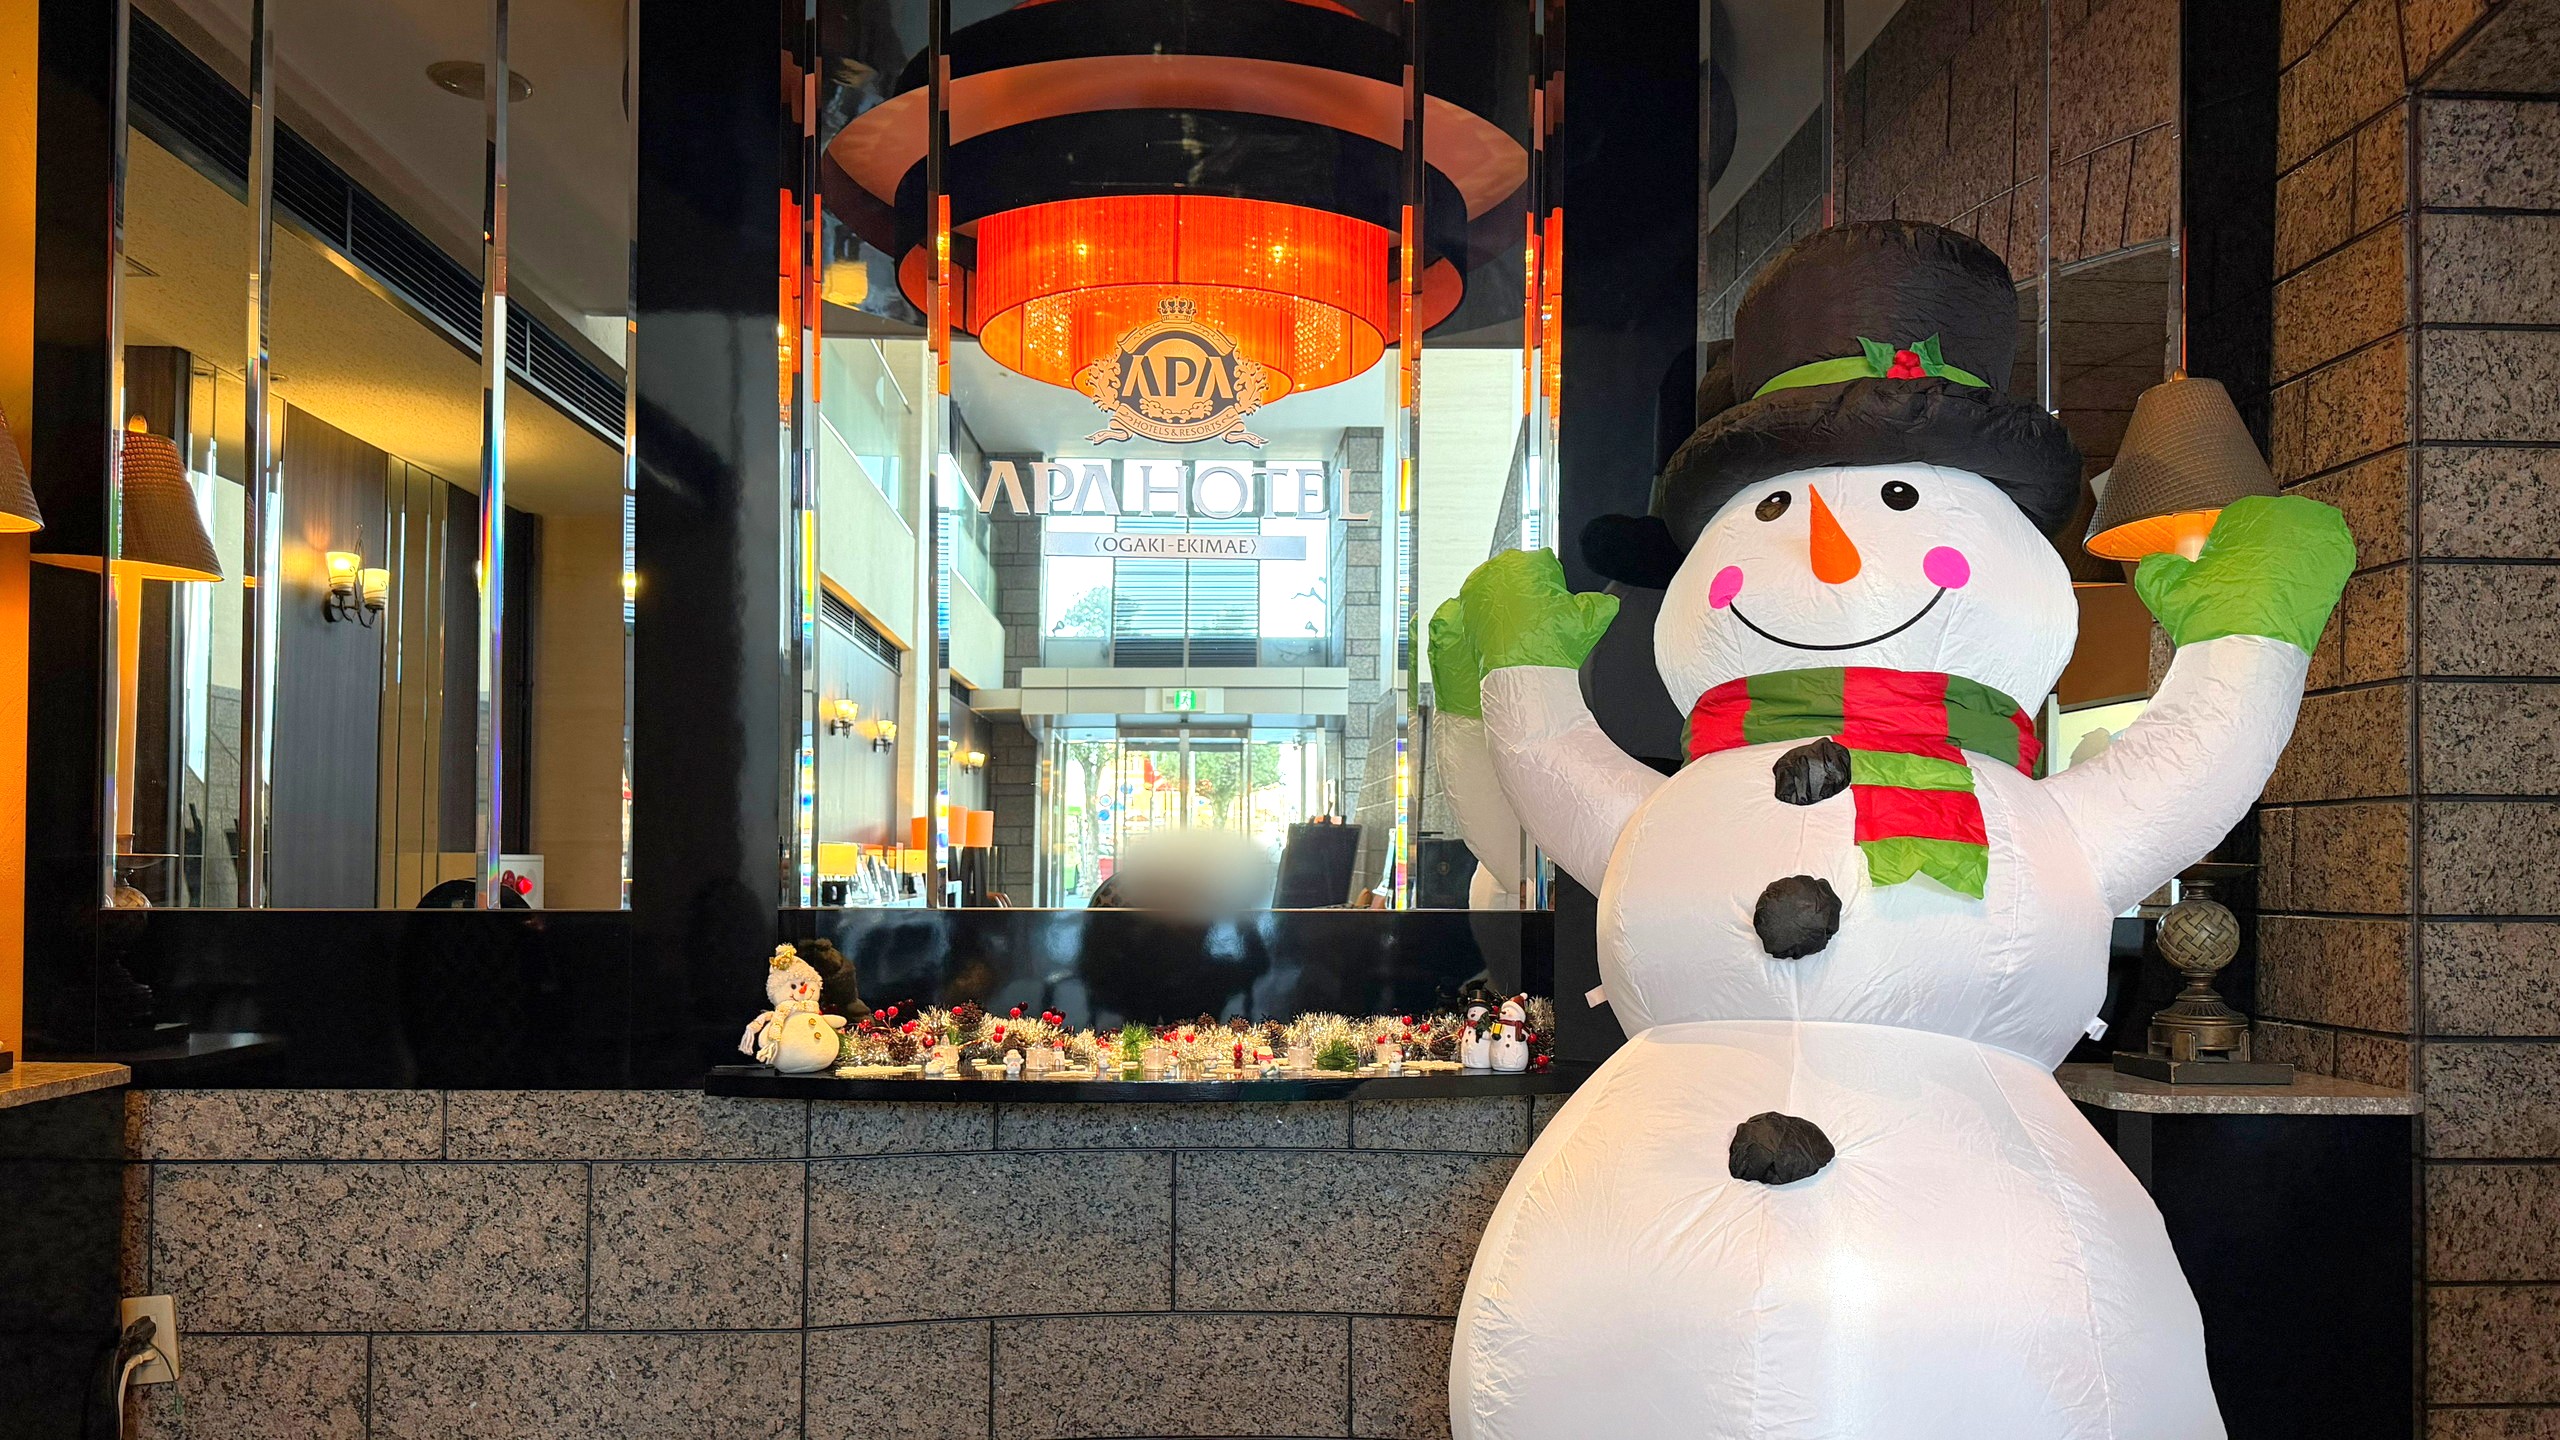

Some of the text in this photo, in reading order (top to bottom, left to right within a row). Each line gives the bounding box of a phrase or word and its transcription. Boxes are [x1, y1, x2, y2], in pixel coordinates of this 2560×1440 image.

[1121, 354, 1235, 398] APA
[979, 460, 1373, 521] APA HOTEL
